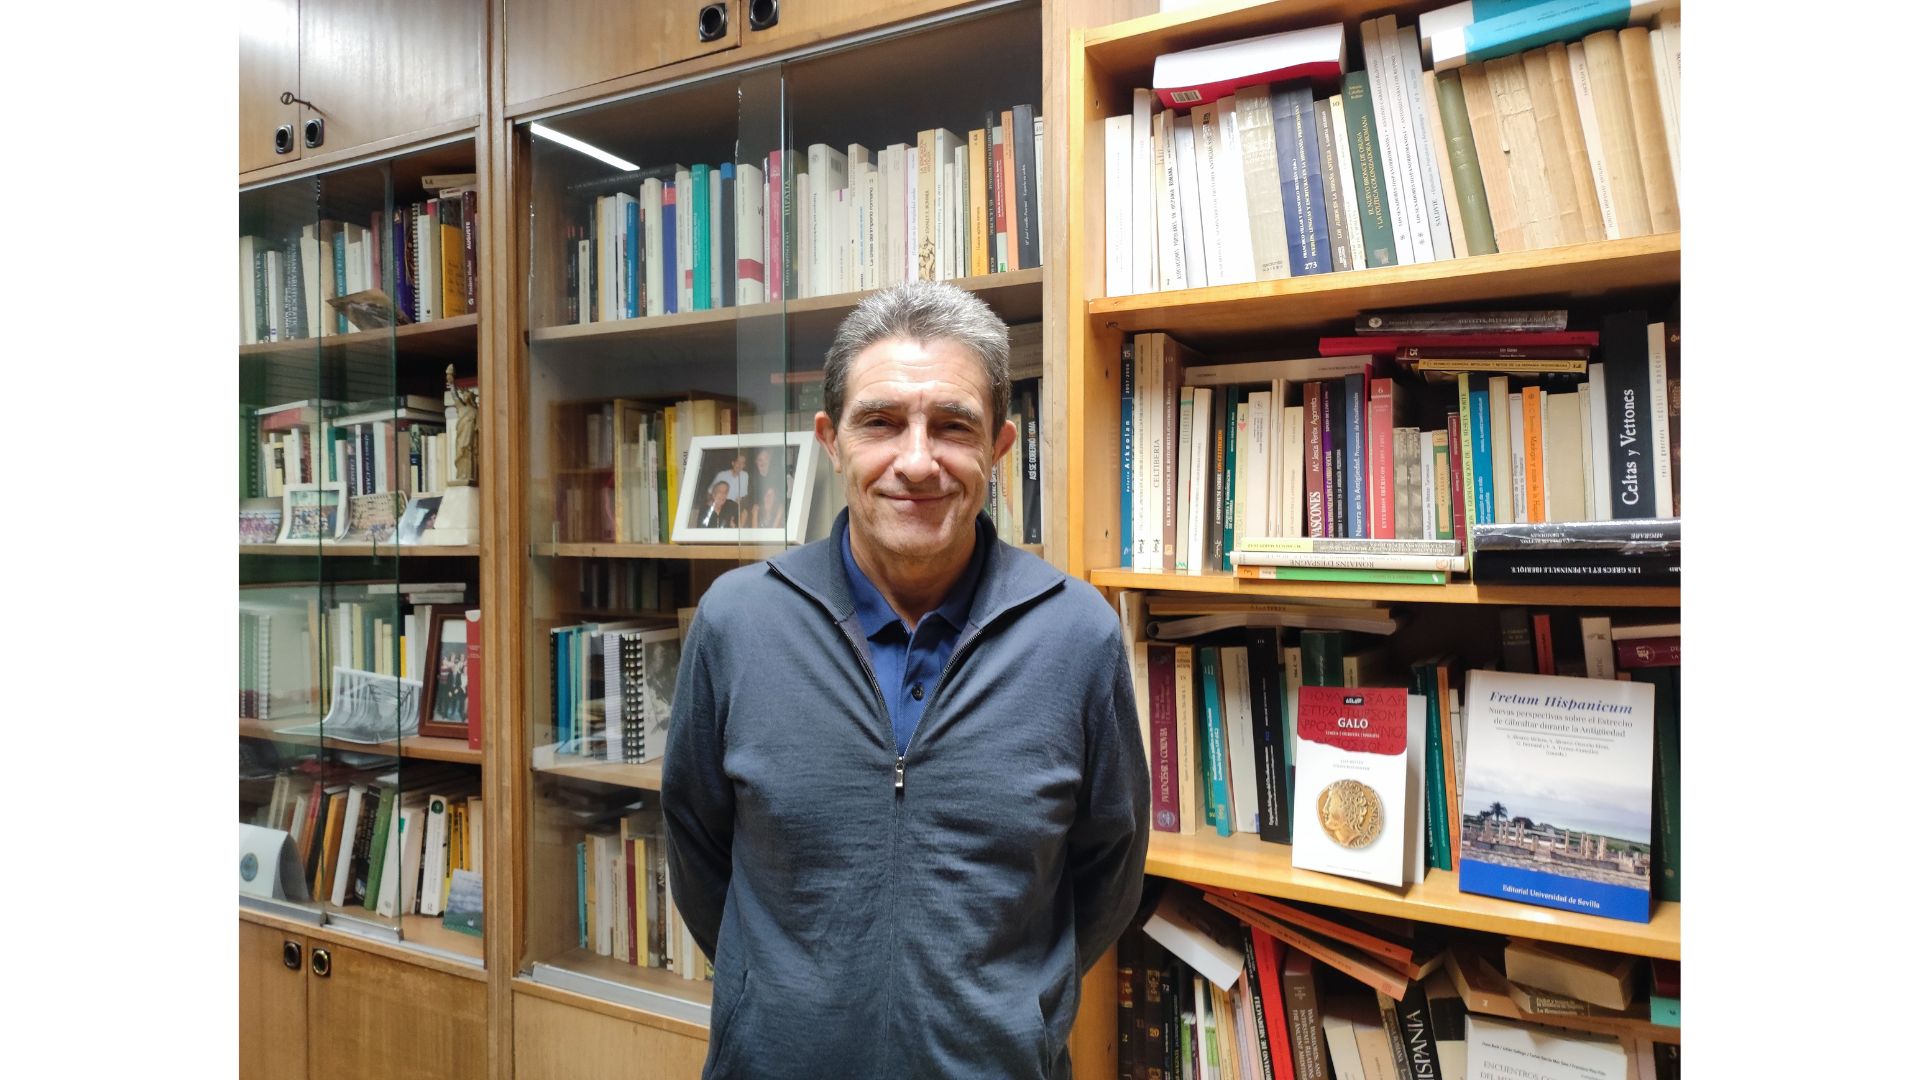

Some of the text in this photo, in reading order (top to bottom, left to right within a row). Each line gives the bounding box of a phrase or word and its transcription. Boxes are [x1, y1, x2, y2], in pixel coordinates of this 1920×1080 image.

[1361, 115, 1371, 141] ROMANA
[1360, 162, 1369, 186] BRONCE
[1364, 187, 1373, 208] NUEVO
[1304, 261, 1318, 270] 273
[1620, 389, 1637, 447] Vettones
[1028, 421, 1036, 438] ROMA
[1028, 438, 1036, 462] GOBERNÓ
[1311, 445, 1319, 460] Jesús
[1028, 471, 1037, 480] ASÍ
[1622, 462, 1639, 505] Celtas
[1309, 491, 1322, 537] VASCONES
[1356, 501, 1361, 510] en
[1336, 560, 1374, 568] ROMAINS
[1490, 692, 1633, 714] Fretum Hispanicum
[1338, 717, 1368, 728] GALO
[1489, 707, 1633, 727] Nuevas perspectivas sobre el Estrecho
[1493, 717, 1625, 737] de Gibraltar durante la Antigüedad
[1503, 884, 1529, 895] Editorial
[1530, 889, 1567, 902] Universidad
[1577, 898, 1600, 908] Sevilla
[1150, 1028, 1159, 1037] 20
[1261, 1040, 1268, 1049] DE
[1305, 1046, 1314, 1079] RELATIONS
[1483, 1061, 1538, 1080] ENCUENTROS
